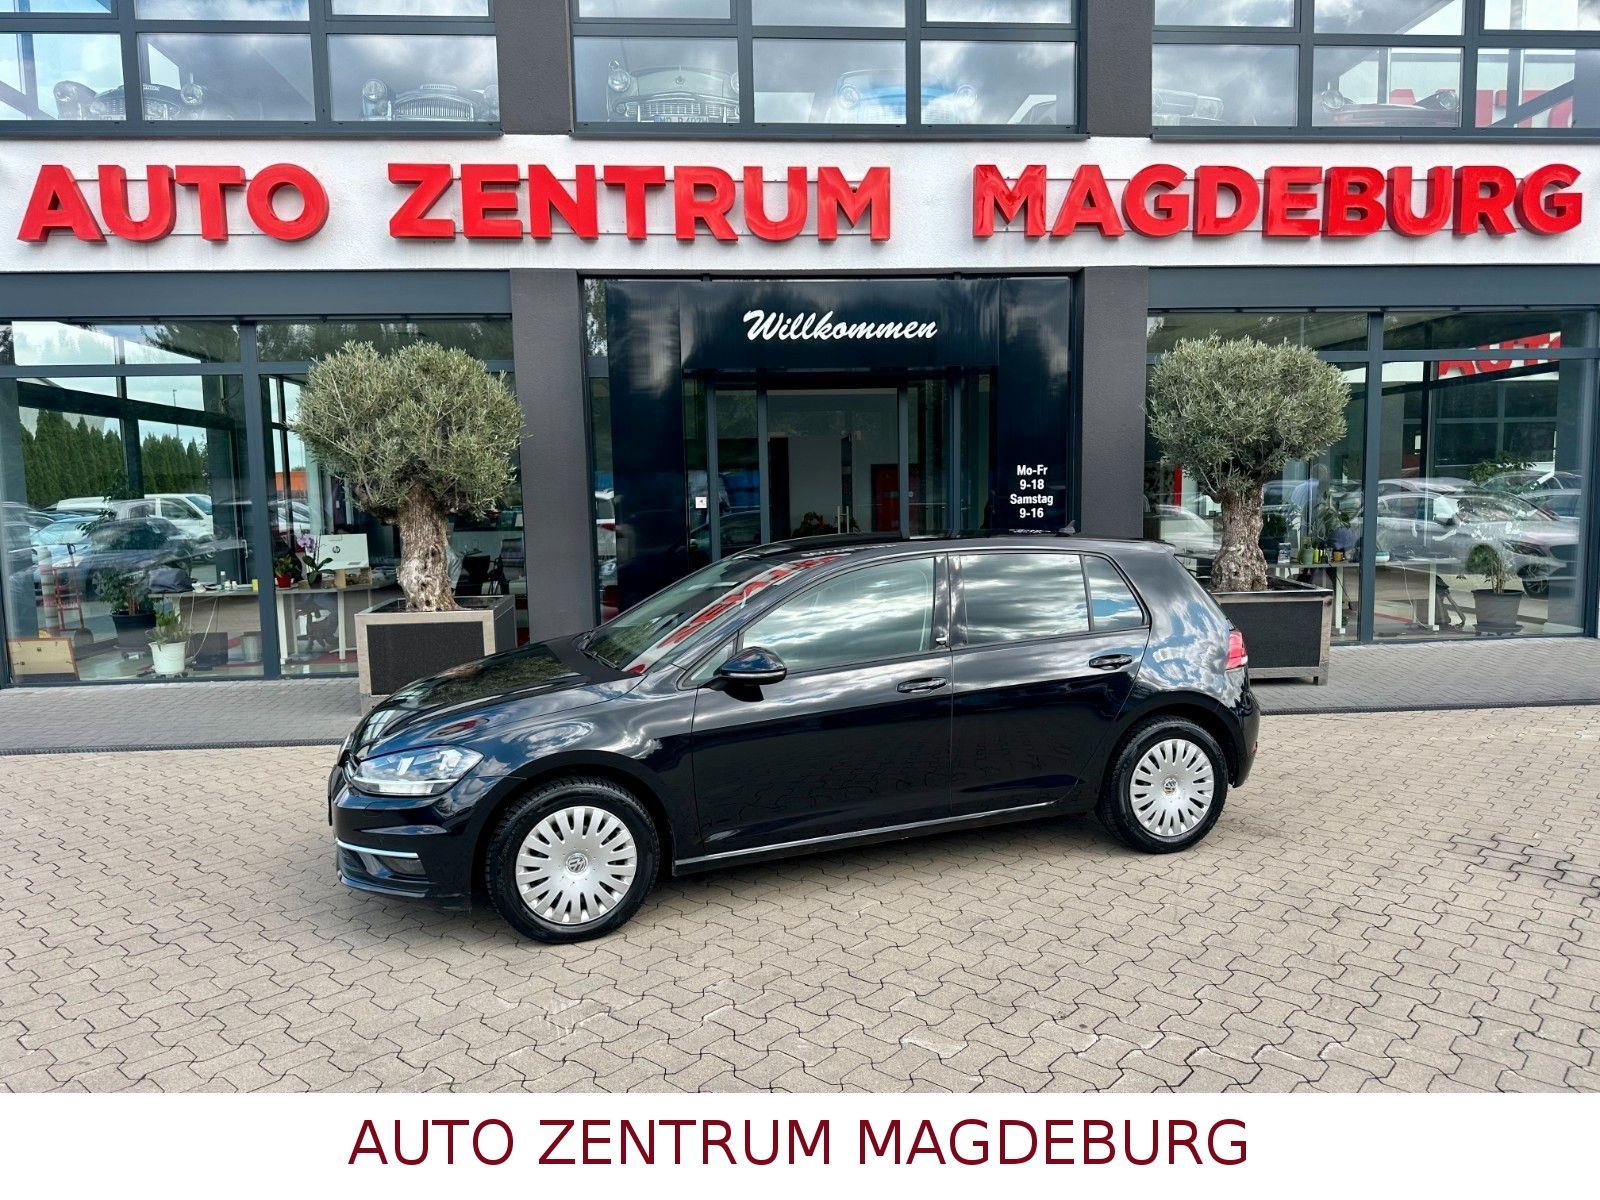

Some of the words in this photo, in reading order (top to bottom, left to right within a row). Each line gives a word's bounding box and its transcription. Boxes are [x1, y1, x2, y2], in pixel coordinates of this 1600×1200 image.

[17, 162, 330, 242] AUTO
[388, 162, 891, 242] ZENTRUM
[973, 162, 1583, 238] MAGDEBURG
[743, 310, 938, 340] Willkommen
[1016, 464, 1048, 476] Mo-Fr
[1020, 479, 1045, 490] 9-18
[1009, 493, 1054, 506] Samstag
[1019, 507, 1044, 518] 9-16
